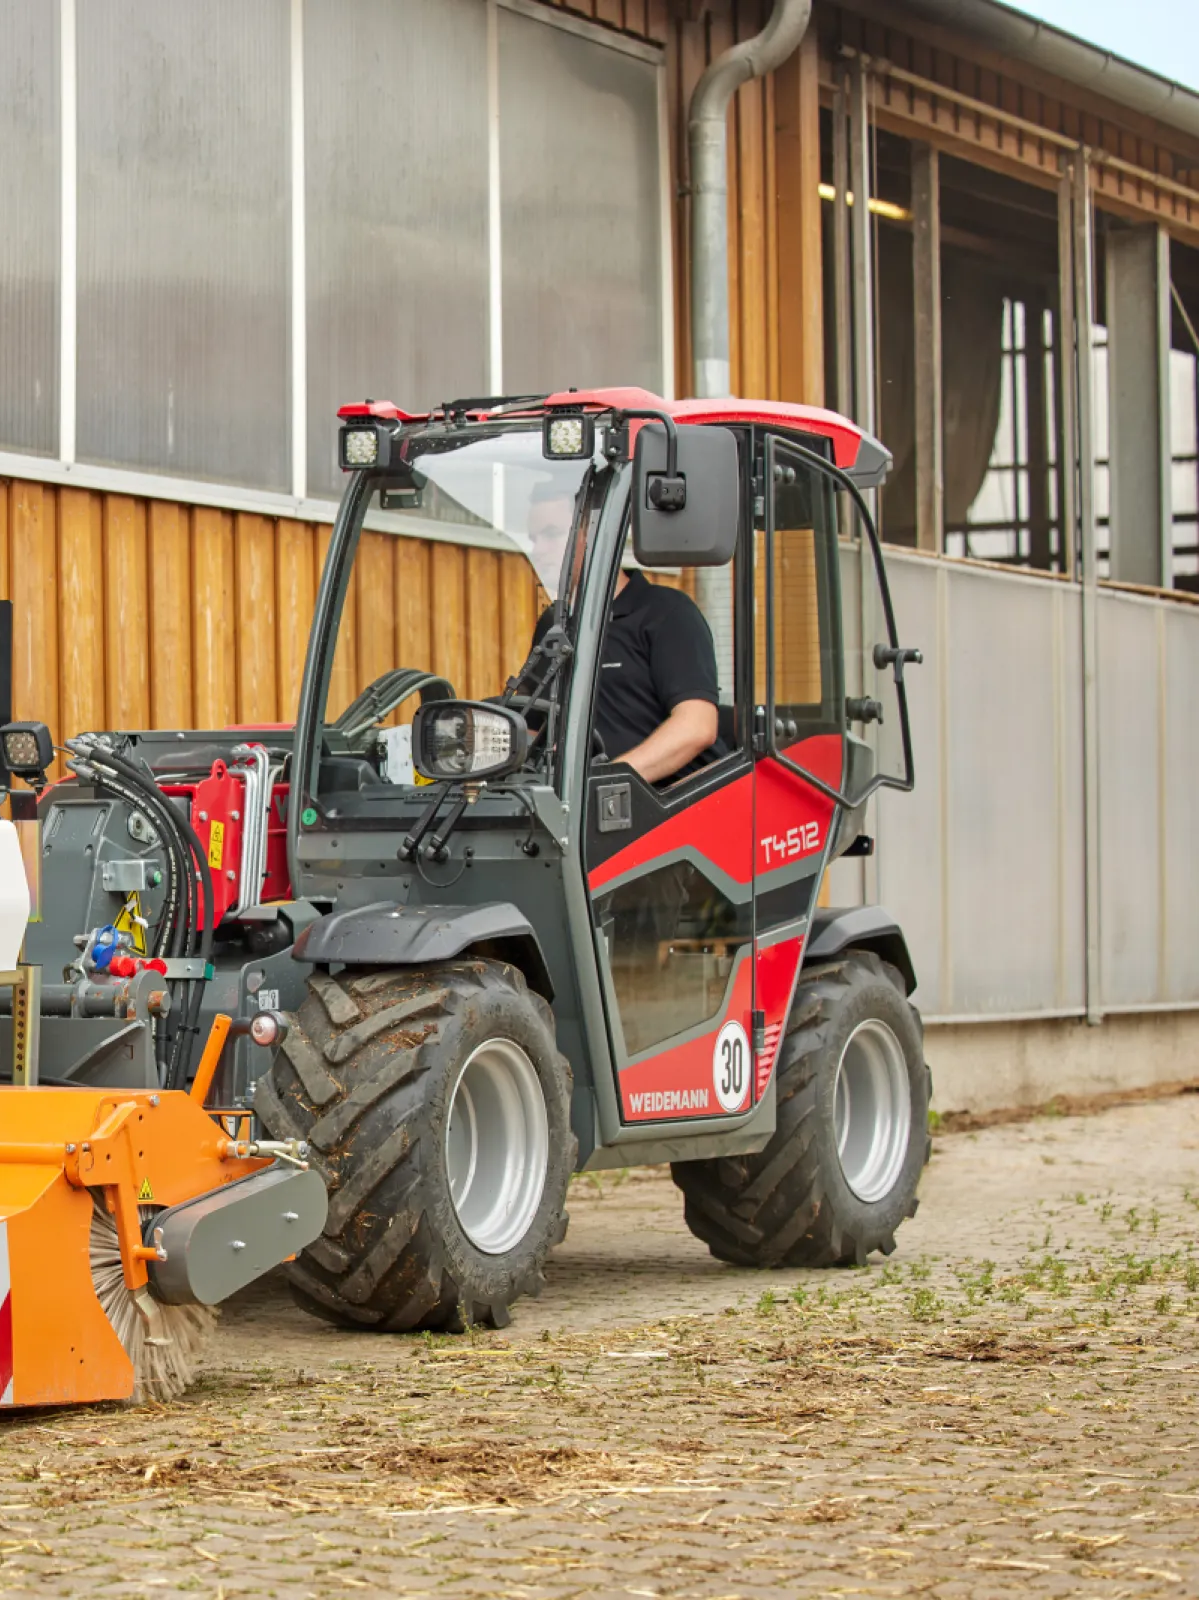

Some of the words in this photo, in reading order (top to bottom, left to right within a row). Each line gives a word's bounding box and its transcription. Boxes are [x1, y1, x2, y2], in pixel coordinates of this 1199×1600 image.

[760, 820, 820, 865] T4512
[721, 1038, 743, 1095] 30
[628, 1088, 710, 1114] WEIDEMANN
